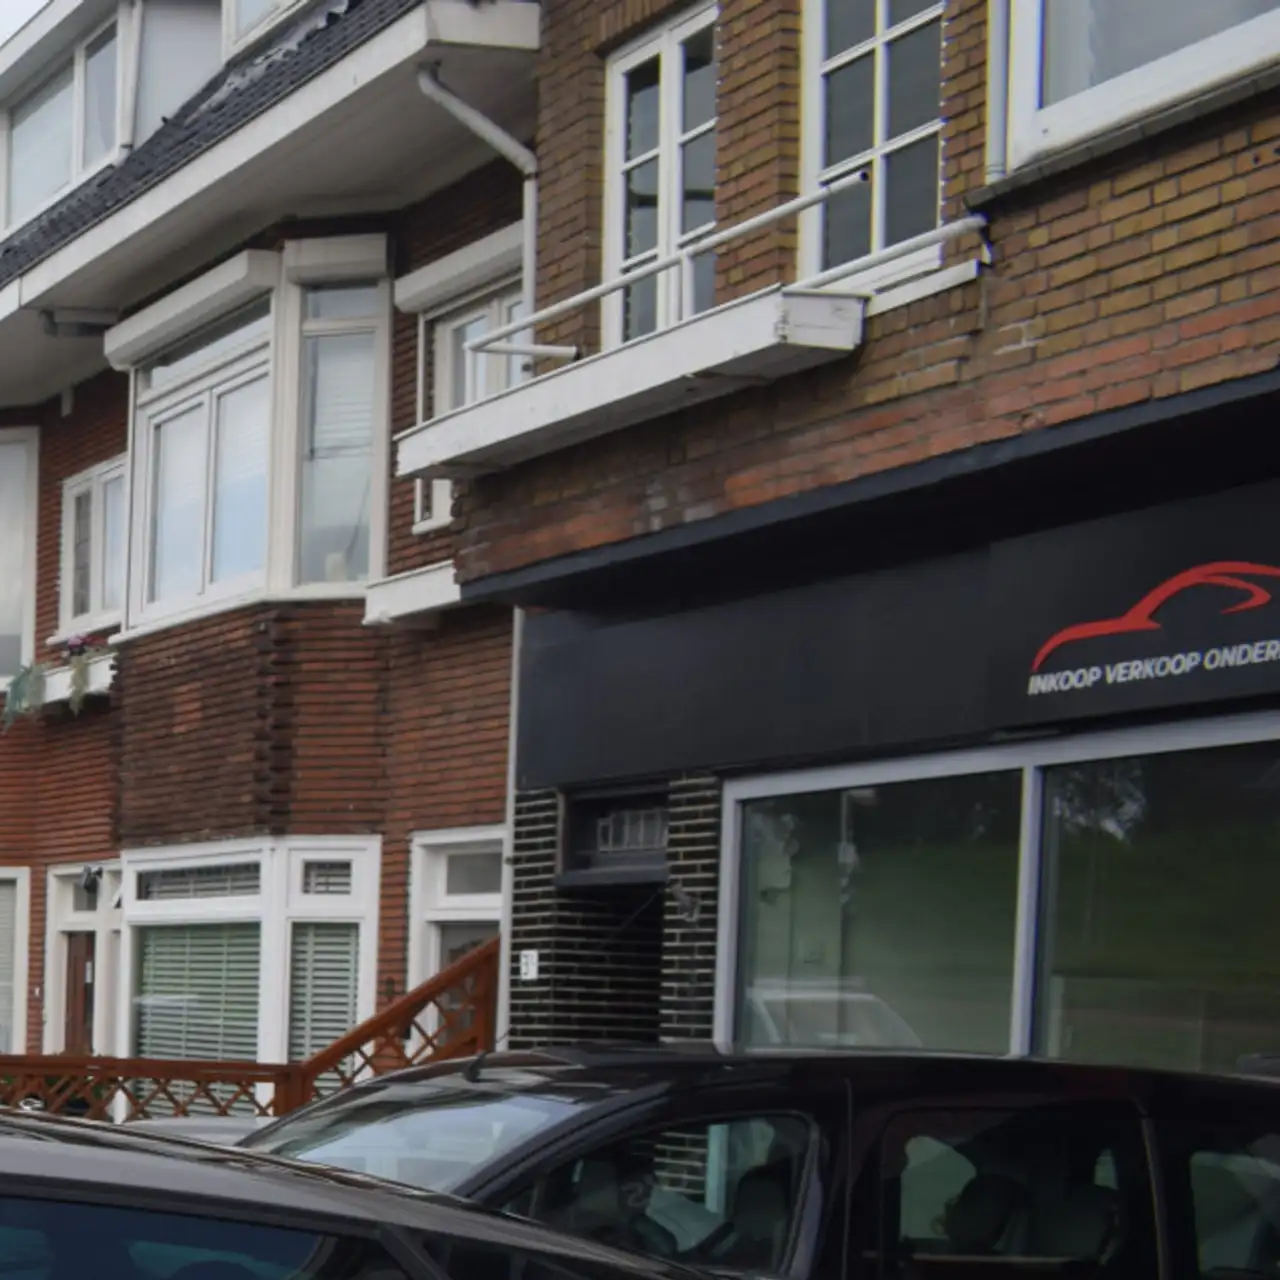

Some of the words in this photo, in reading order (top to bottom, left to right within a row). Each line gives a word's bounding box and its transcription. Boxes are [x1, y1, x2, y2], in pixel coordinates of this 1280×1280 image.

[1027, 667, 1102, 695] INKOOP
[1105, 652, 1201, 683] VERKOOP
[1203, 639, 1280, 671] ONDER
